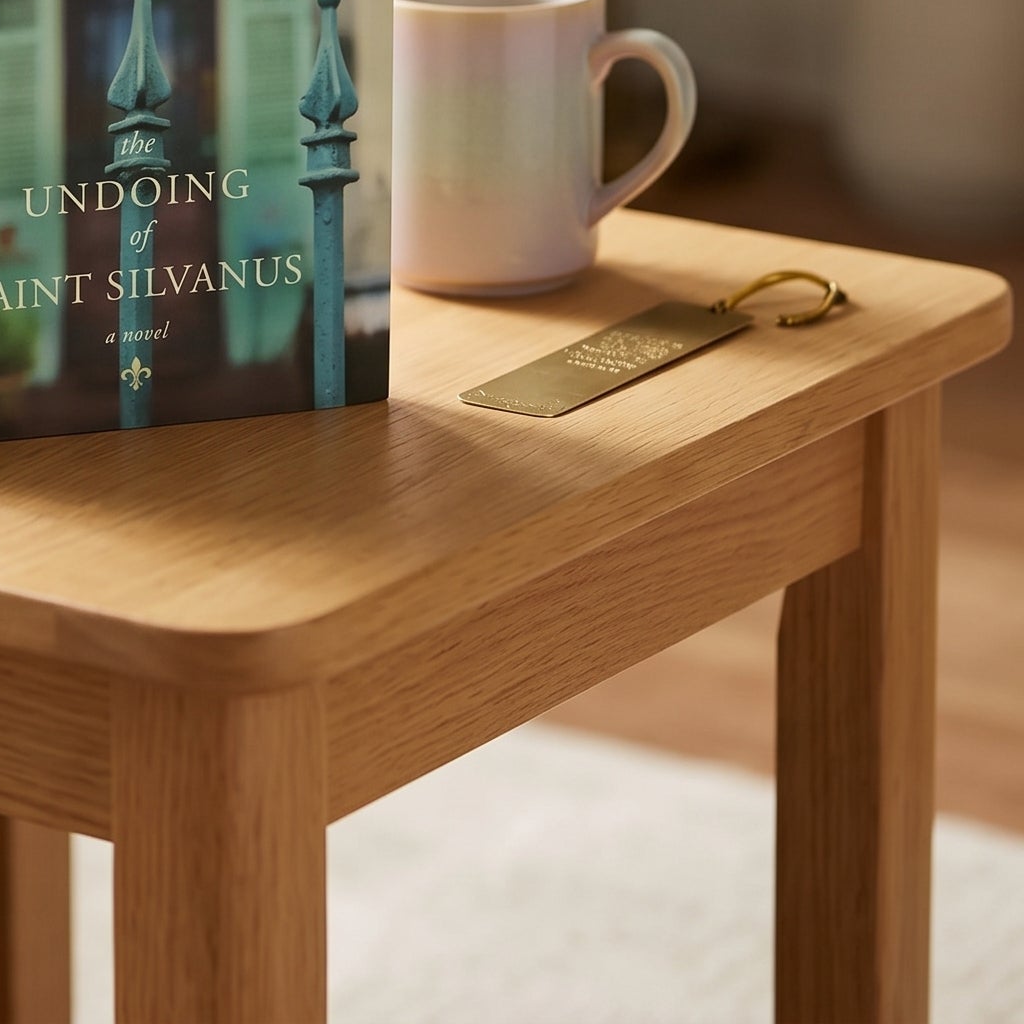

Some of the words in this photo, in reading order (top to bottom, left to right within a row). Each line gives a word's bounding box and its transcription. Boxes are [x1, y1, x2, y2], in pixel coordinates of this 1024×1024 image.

[120, 130, 157, 155] the
[22, 169, 250, 217] UNDOING
[130, 219, 158, 253] of
[106, 254, 303, 302] SILVANUS
[105, 331, 116, 345] a
[123, 321, 170, 342] novel
